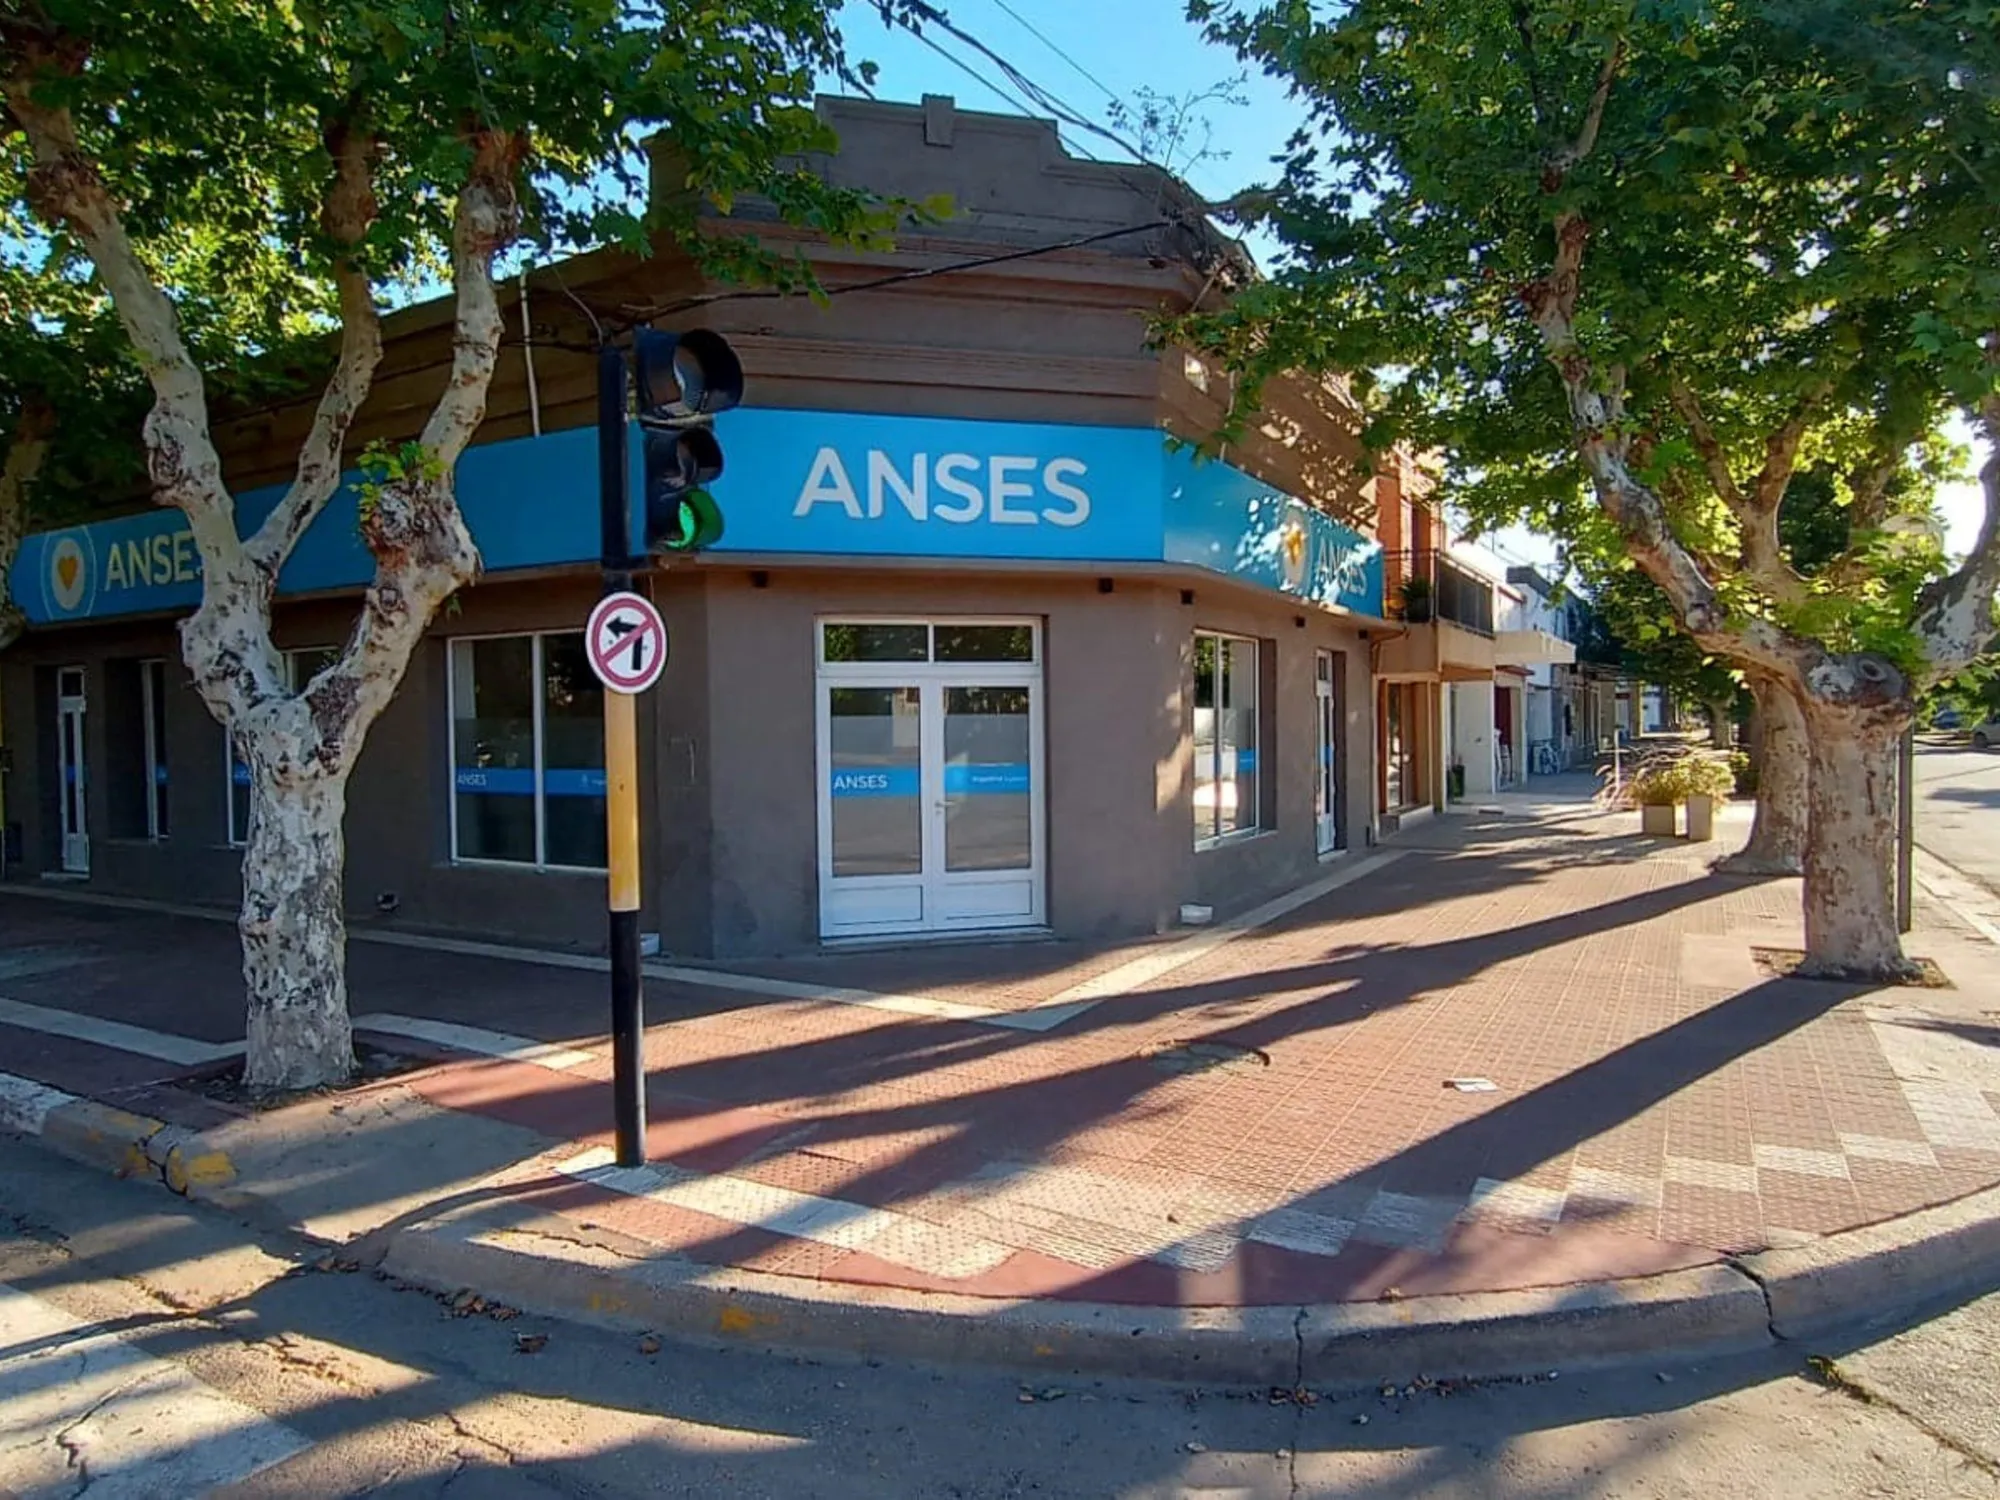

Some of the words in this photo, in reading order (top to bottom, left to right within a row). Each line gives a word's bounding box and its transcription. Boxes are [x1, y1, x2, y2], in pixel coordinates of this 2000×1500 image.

[792, 447, 1091, 527] ANSES
[104, 531, 201, 591] ANSE
[833, 774, 888, 790] ANSES
